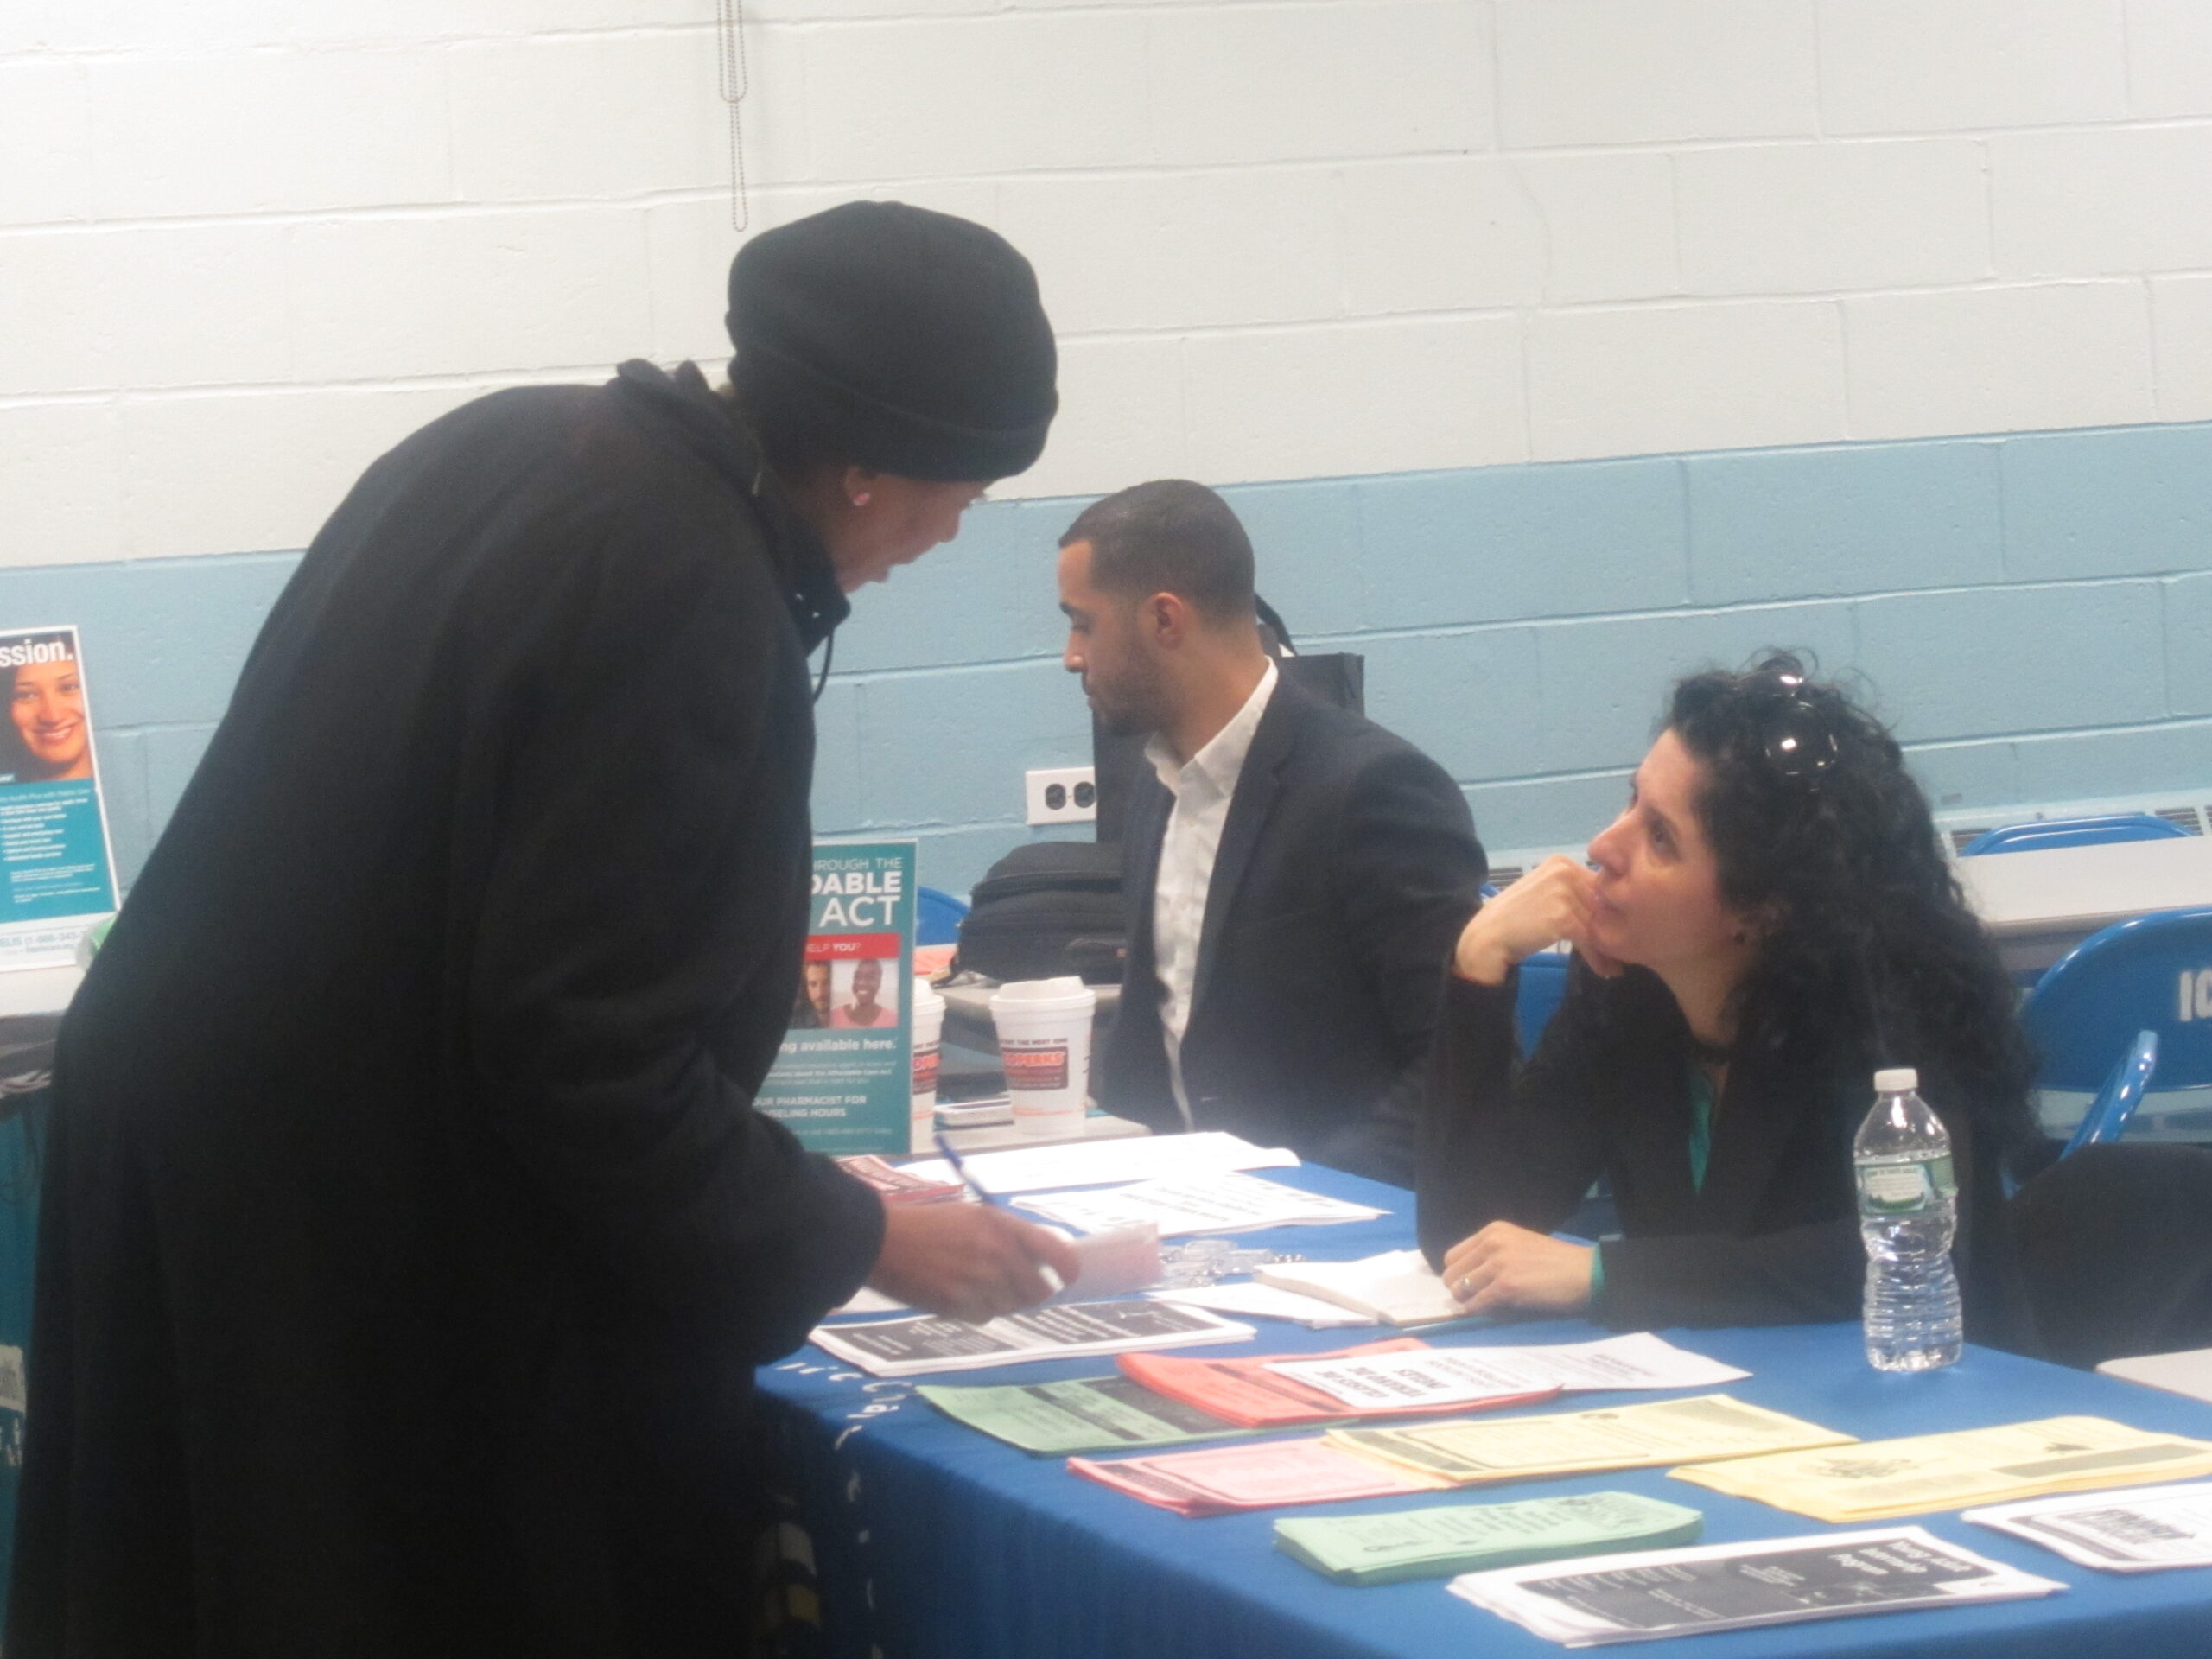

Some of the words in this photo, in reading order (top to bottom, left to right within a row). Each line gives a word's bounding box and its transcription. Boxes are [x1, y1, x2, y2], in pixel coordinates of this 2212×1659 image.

[0, 639, 73, 667] ssion.
[875, 857, 902, 869] THE
[818, 895, 900, 927] ACT
[833, 942, 861, 952] YOU?
[801, 1039, 860, 1051] available
[777, 1096, 842, 1106] PHARMACIST
[845, 1095, 867, 1104] FOR
[810, 1107, 847, 1117] HOURS
